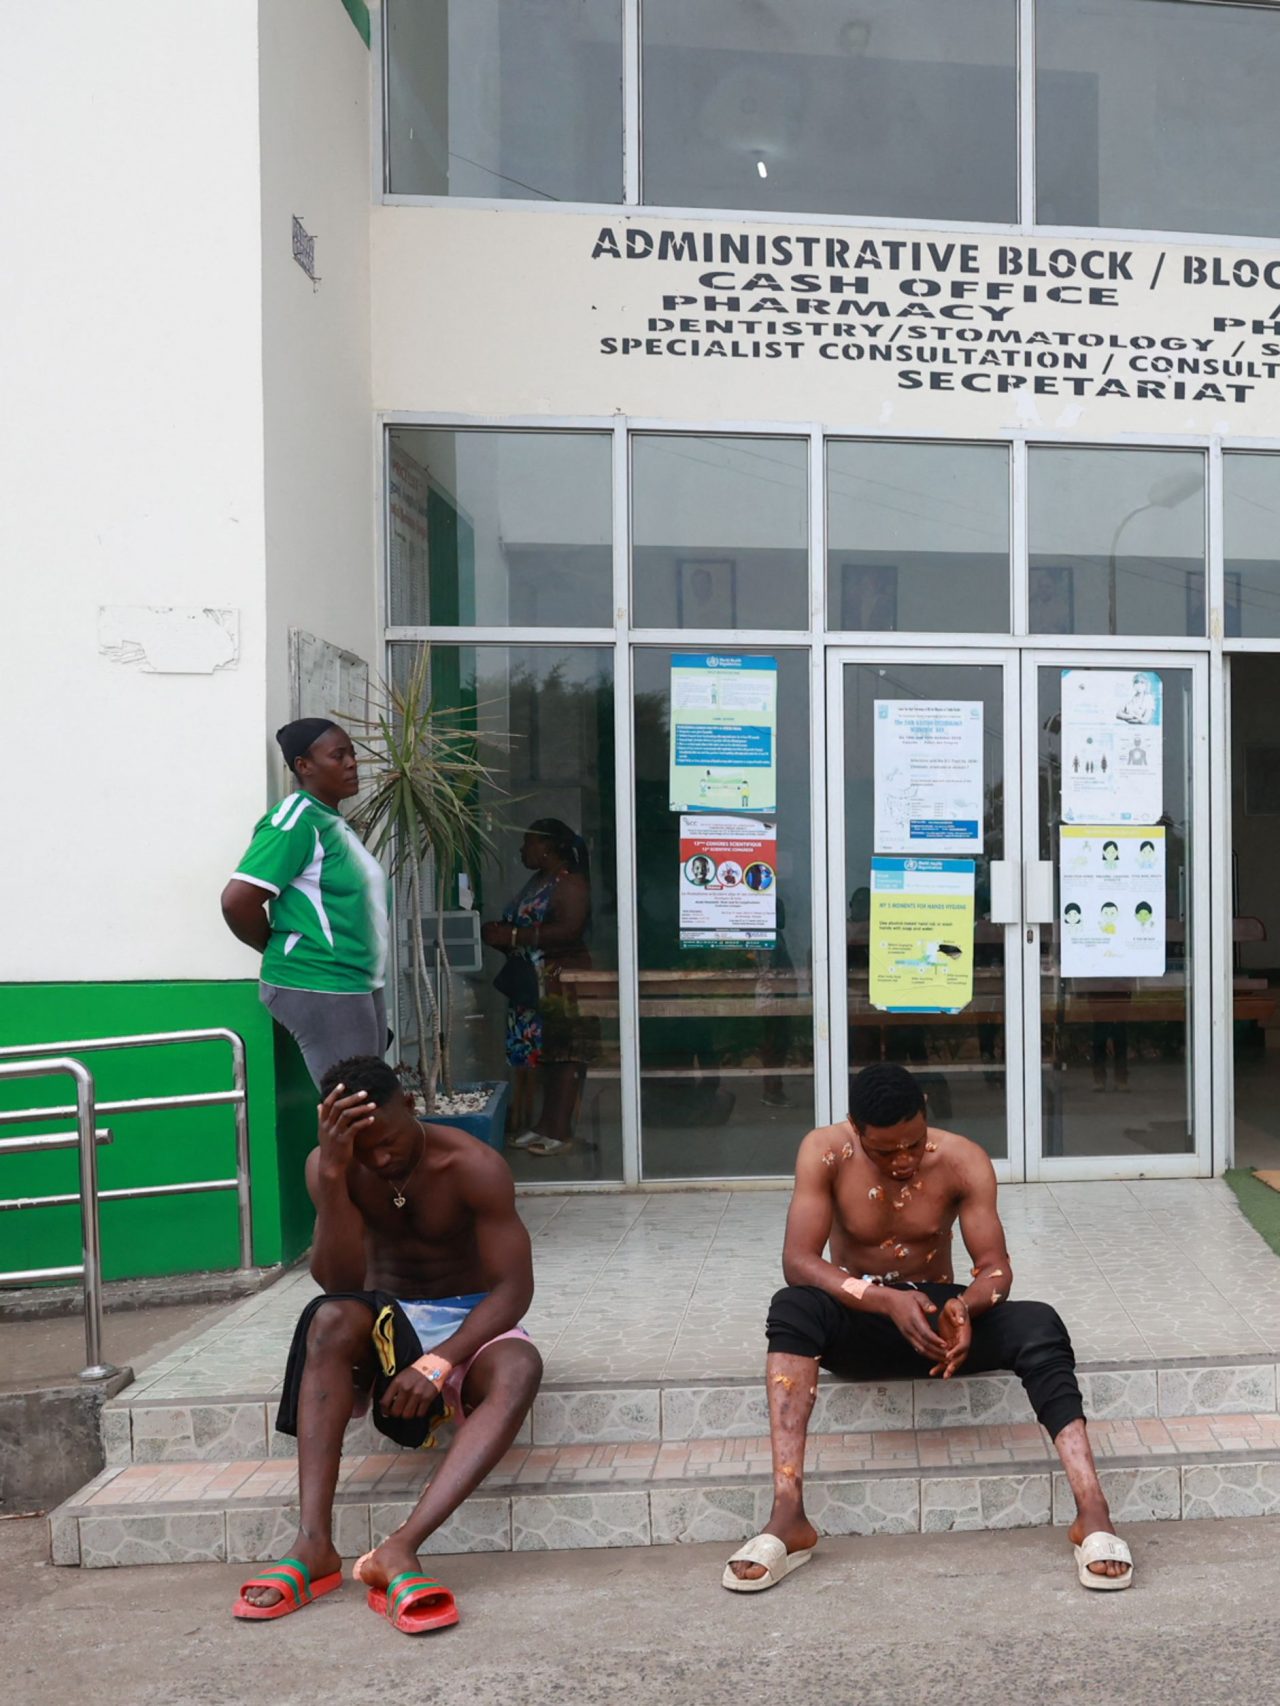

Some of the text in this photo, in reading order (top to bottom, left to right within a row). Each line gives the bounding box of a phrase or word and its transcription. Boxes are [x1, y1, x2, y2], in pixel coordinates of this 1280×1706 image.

[592, 227, 981, 274] ADMINISTRATIVE
[998, 246, 1133, 281] BLOCK
[1149, 252, 1166, 290] /
[698, 271, 870, 295] CASH
[899, 279, 1120, 307] OFFICE
[662, 295, 1015, 322] PHARMACY
[600, 337, 805, 360] SPECIALIST
[819, 343, 1088, 370] CONSULTATION
